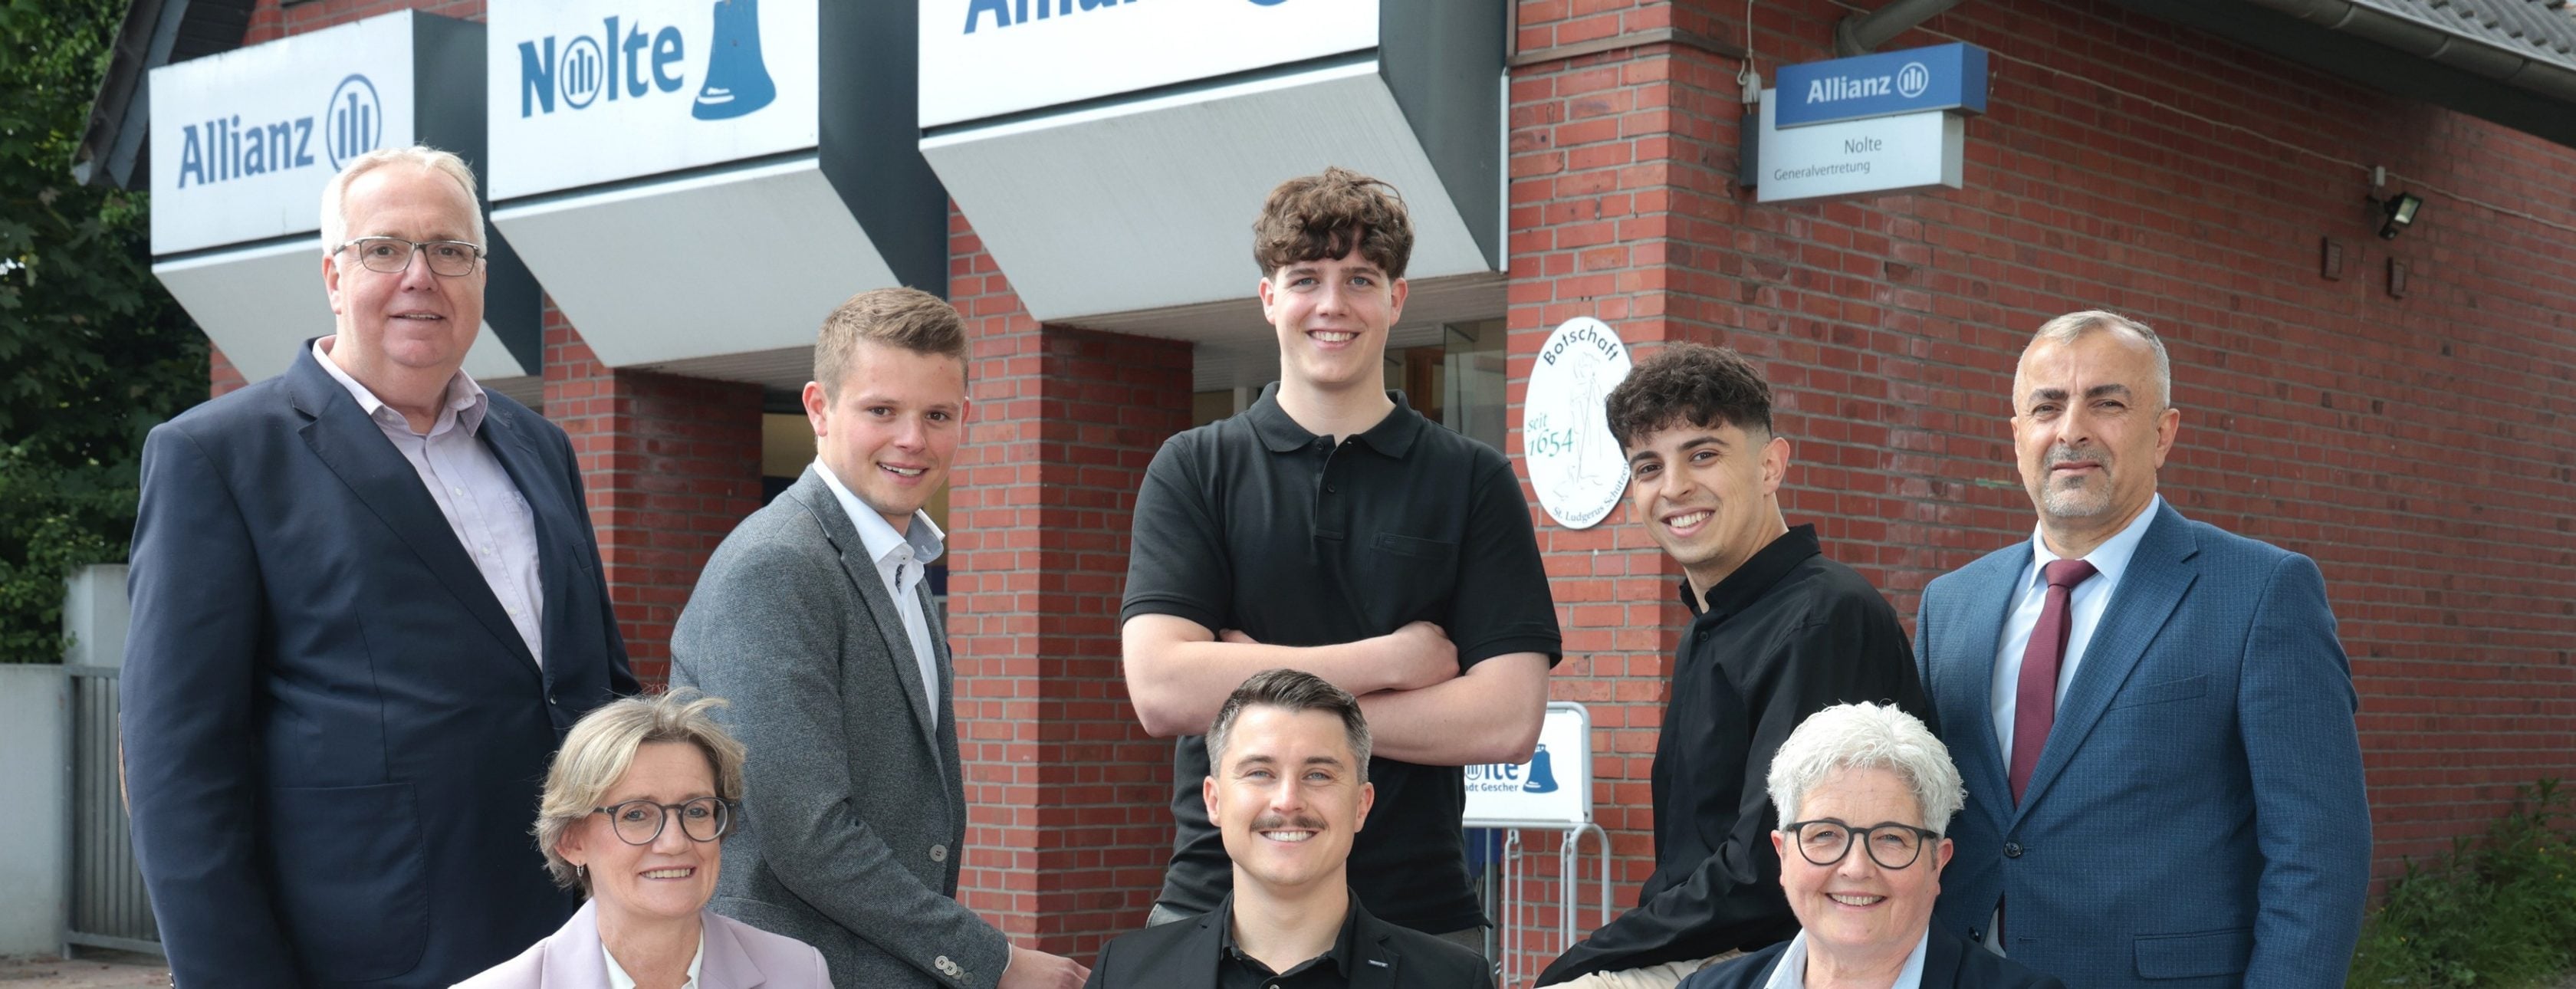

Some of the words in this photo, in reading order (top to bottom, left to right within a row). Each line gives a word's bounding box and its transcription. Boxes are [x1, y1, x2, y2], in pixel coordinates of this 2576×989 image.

[518, 15, 684, 119] Nolte
[1806, 75, 1891, 104] Allianz
[178, 114, 314, 189] Allianz
[1845, 136, 1882, 153] Nolte
[1774, 161, 1871, 181] Generalvertretung
[1543, 325, 1618, 366] Botschaft
[1527, 412, 1548, 432] seit
[1528, 428, 1574, 458] 1654
[1565, 506, 1604, 524] Ludgerus
[1480, 782, 1519, 792] Gescher
